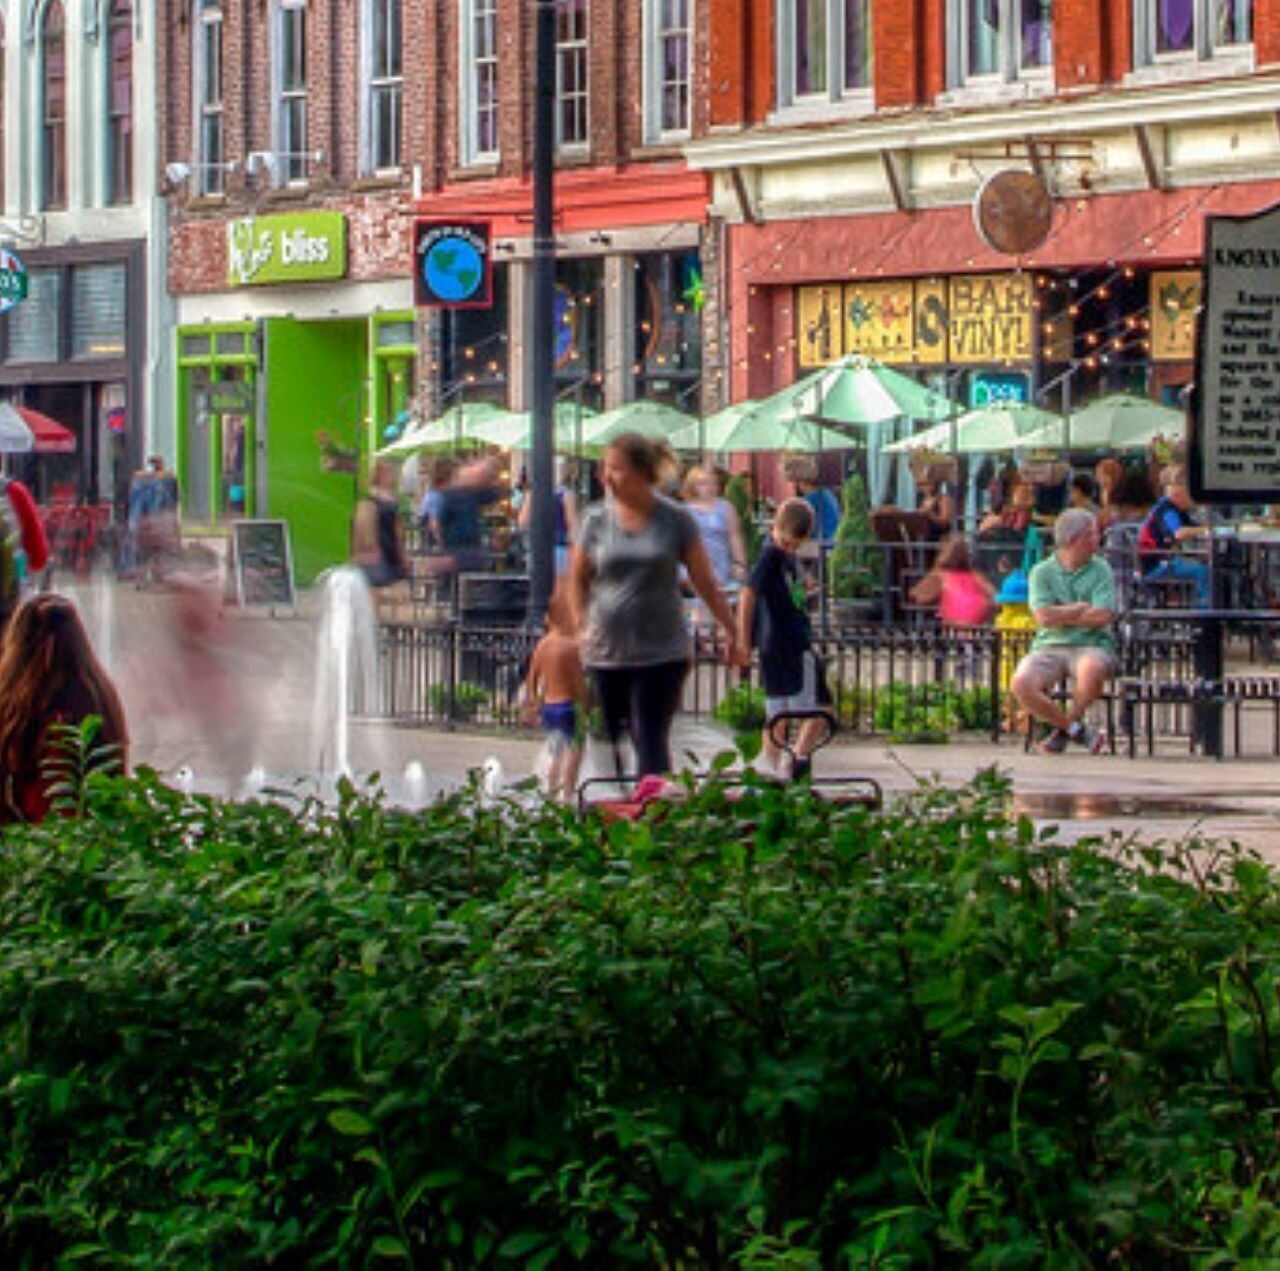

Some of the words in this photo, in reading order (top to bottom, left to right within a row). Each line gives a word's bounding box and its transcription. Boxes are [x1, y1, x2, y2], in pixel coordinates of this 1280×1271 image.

[281, 227, 328, 265] bliss
[954, 276, 1029, 314] BAR
[952, 317, 1031, 357] VINYL
